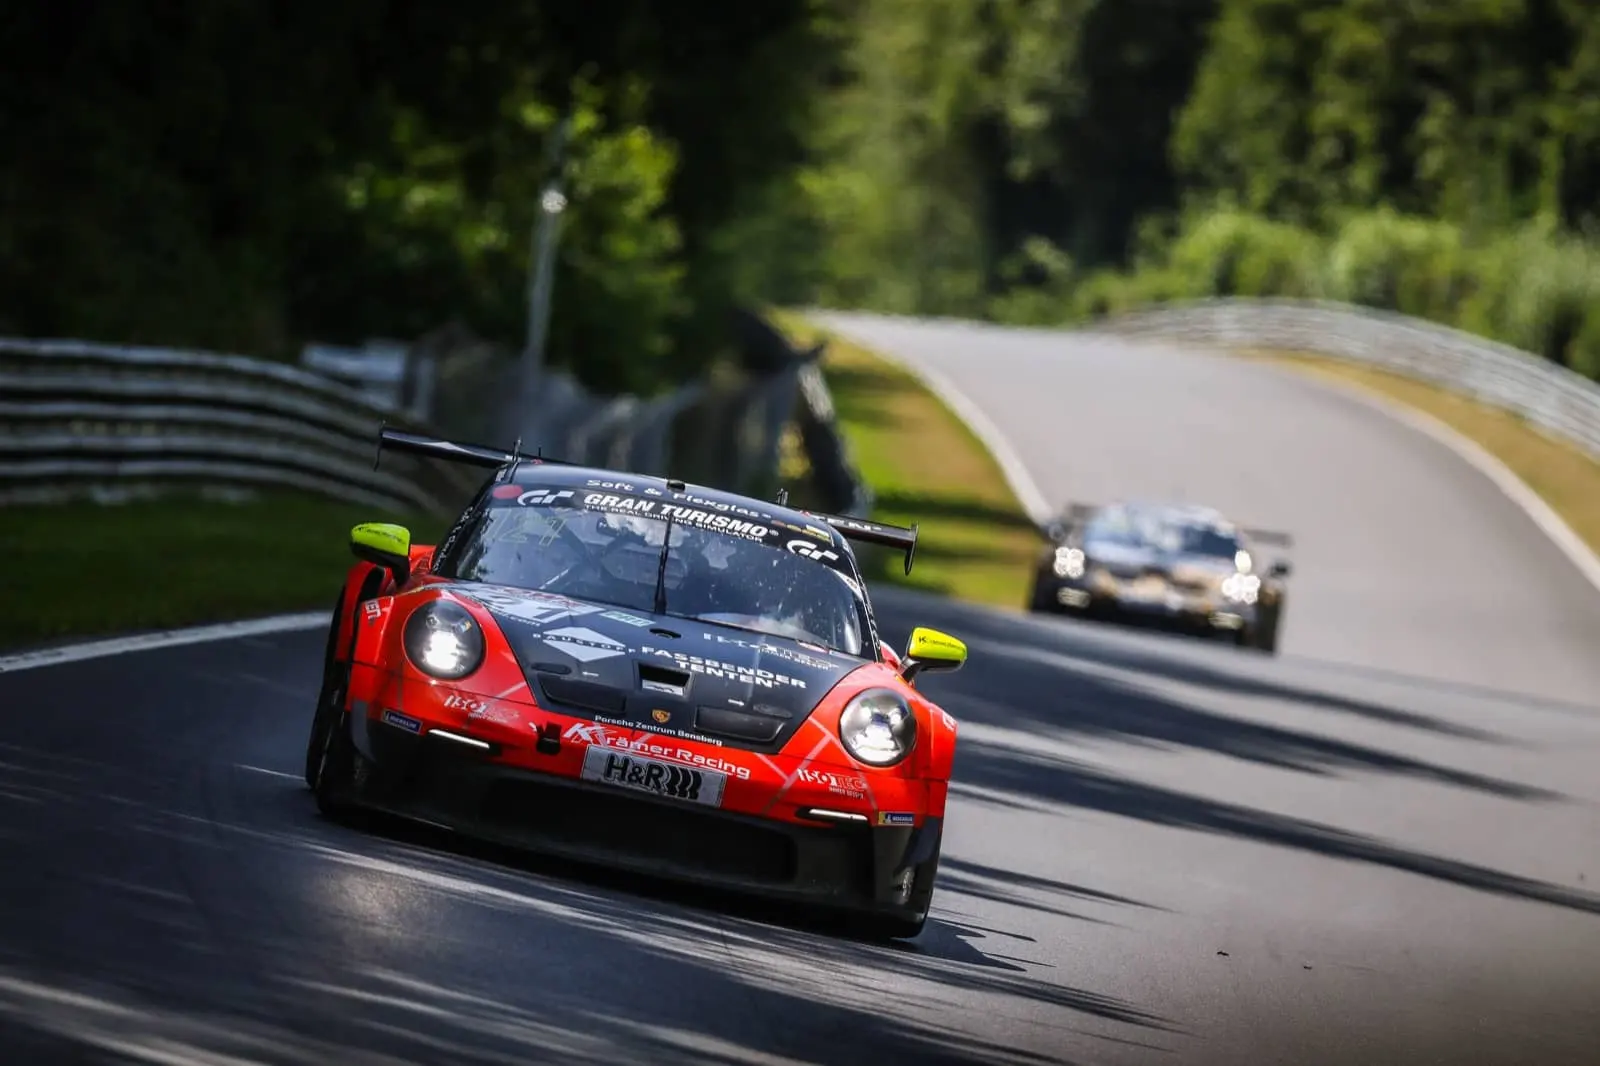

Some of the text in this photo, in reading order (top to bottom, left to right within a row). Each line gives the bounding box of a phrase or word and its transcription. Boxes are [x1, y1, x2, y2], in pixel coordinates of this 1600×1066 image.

[586, 478, 635, 492] Soft
[583, 493, 656, 513] GRAN
[695, 522, 763, 543] SIMULATOR
[641, 645, 807, 689] FASSBENDER
[594, 714, 724, 747] Porsche Zentrum Bensberg
[675, 747, 752, 781] Racing
